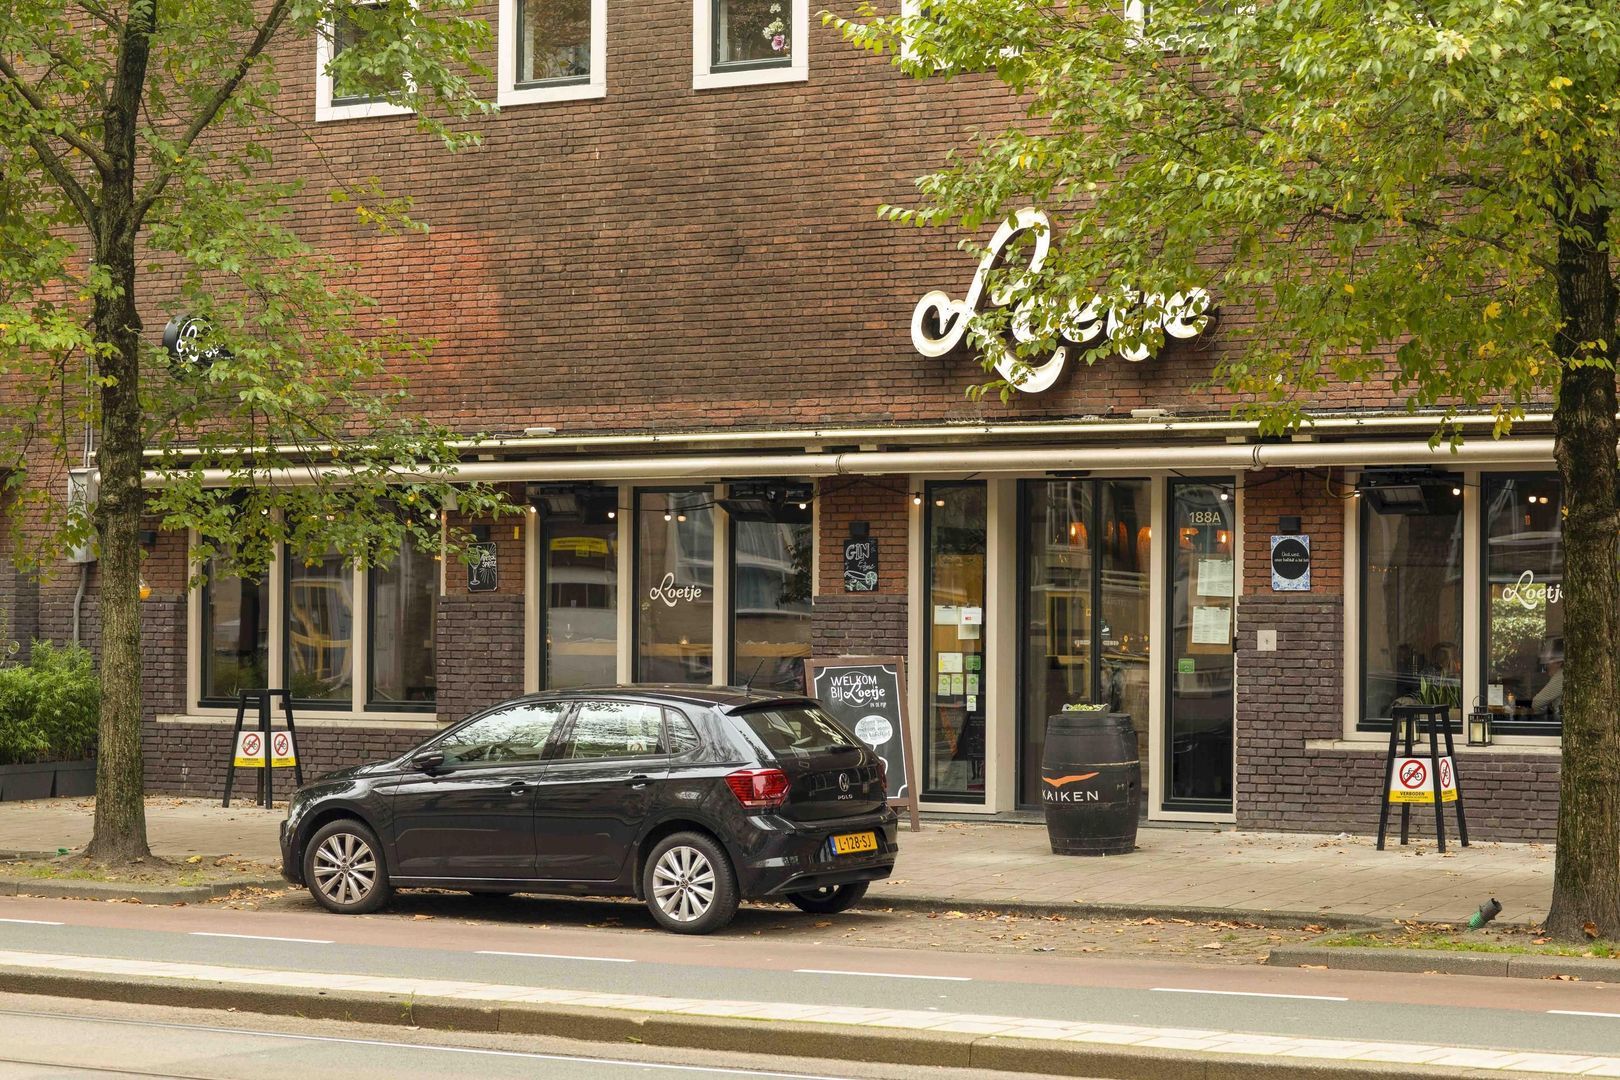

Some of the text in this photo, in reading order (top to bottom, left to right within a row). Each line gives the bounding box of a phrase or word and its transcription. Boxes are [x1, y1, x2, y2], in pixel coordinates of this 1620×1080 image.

[1189, 511, 1221, 523] 188A
[845, 543, 870, 560] GIN
[650, 572, 702, 607] Loetje
[830, 675, 877, 686] WELKOM
[830, 681, 886, 703] BIJ Loetje
[838, 834, 872, 851] L-128-SJ
